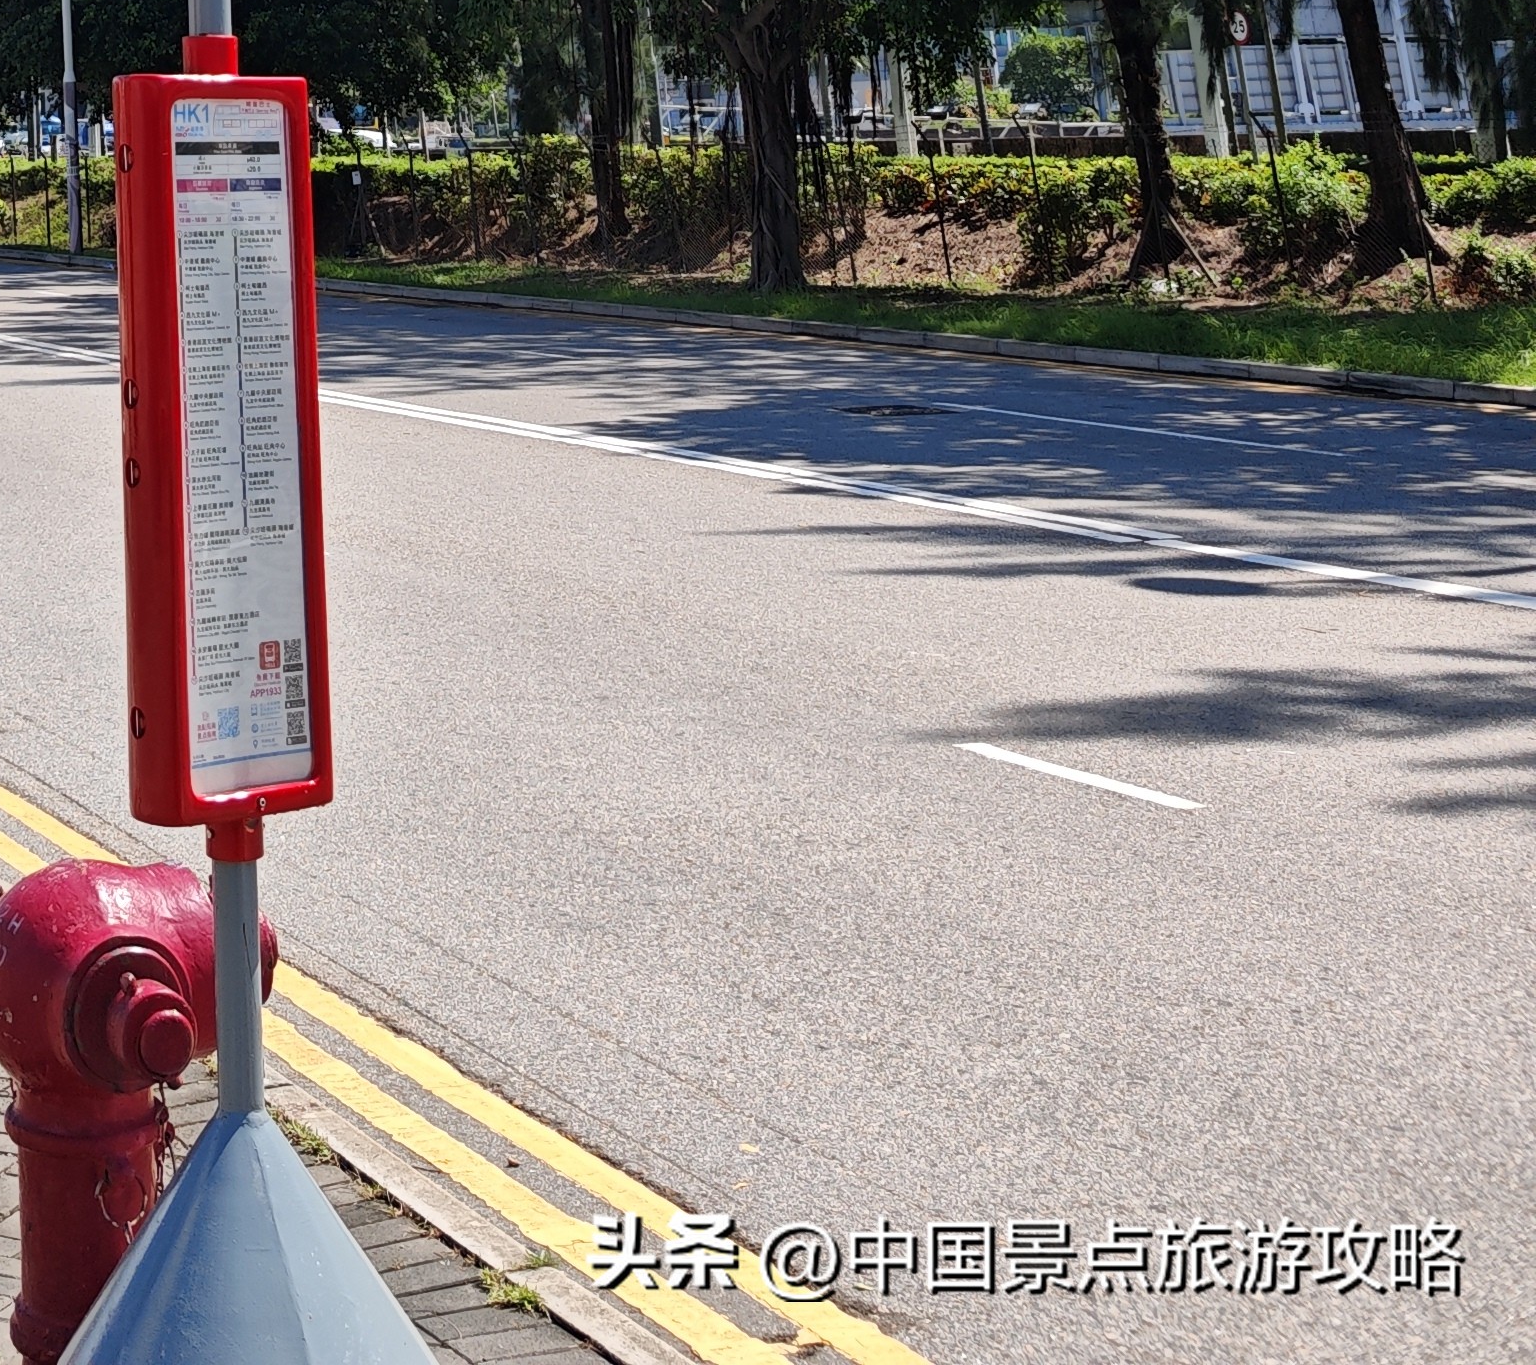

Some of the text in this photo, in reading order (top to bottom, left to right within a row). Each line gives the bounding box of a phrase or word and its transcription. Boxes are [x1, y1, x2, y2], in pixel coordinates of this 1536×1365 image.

[1231, 20, 1245, 33] 25
[173, 103, 209, 124] HK1
[250, 687, 282, 698] APP1933
